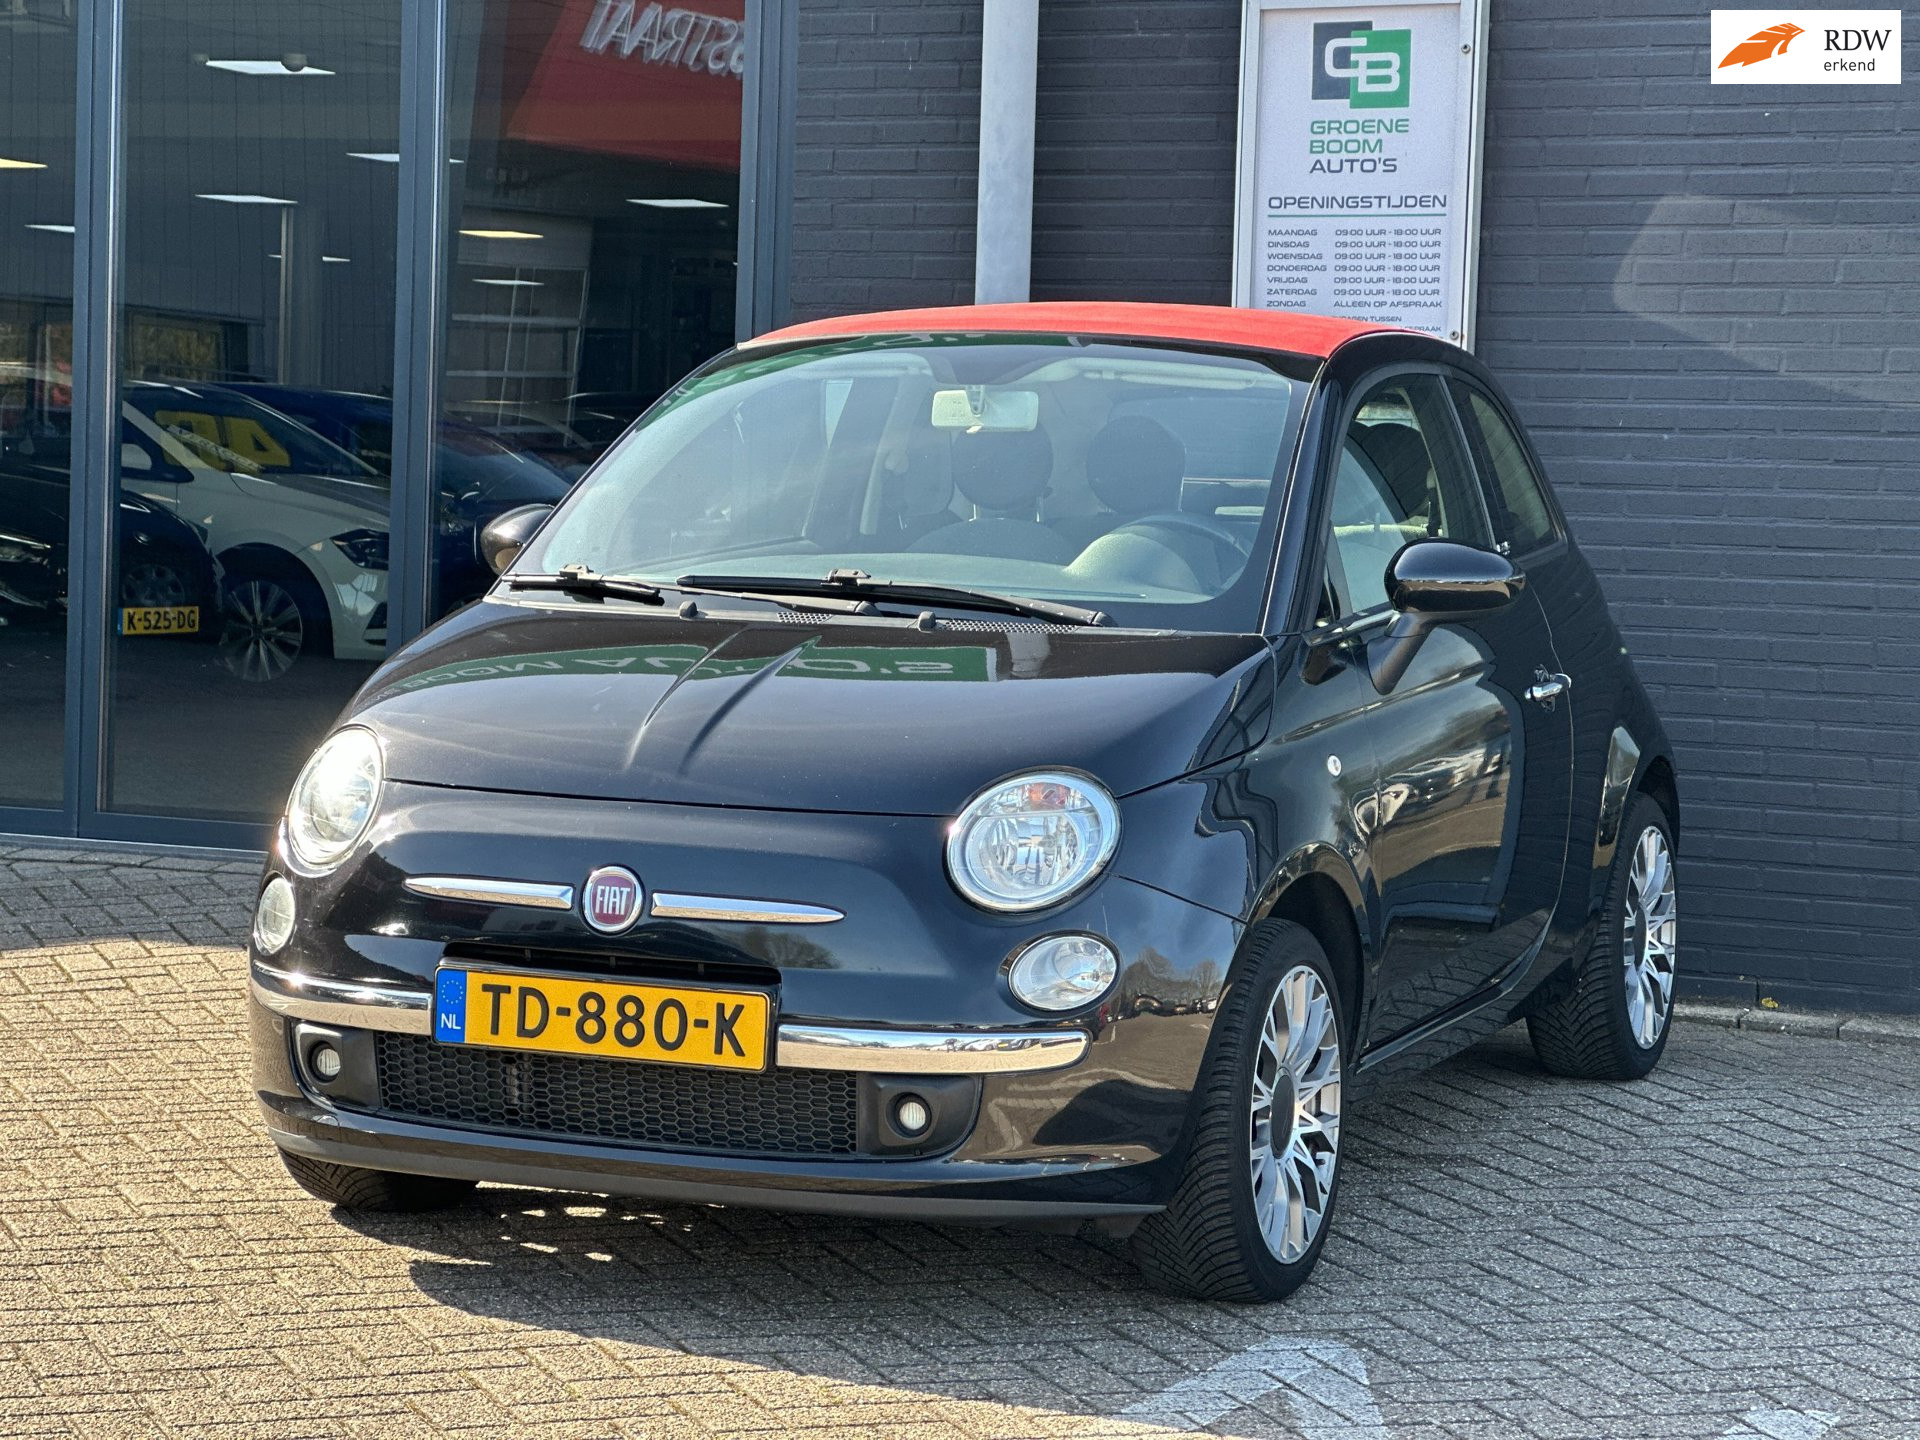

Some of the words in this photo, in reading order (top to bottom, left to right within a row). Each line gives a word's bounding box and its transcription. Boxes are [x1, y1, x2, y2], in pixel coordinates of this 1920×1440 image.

[1310, 118, 1410, 135] GROENE
[1309, 138, 1383, 154] BOOM
[1309, 157, 1397, 174] AUTO'S
[1268, 195, 1447, 209] OPENINGSTIJDEN
[1365, 228, 1387, 236] UUR
[1420, 228, 1442, 236] UUR
[127, 610, 196, 631] K-525-DG
[595, 884, 630, 916] FIAT
[441, 1013, 461, 1030] NL
[481, 983, 746, 1057] TD-880-K
